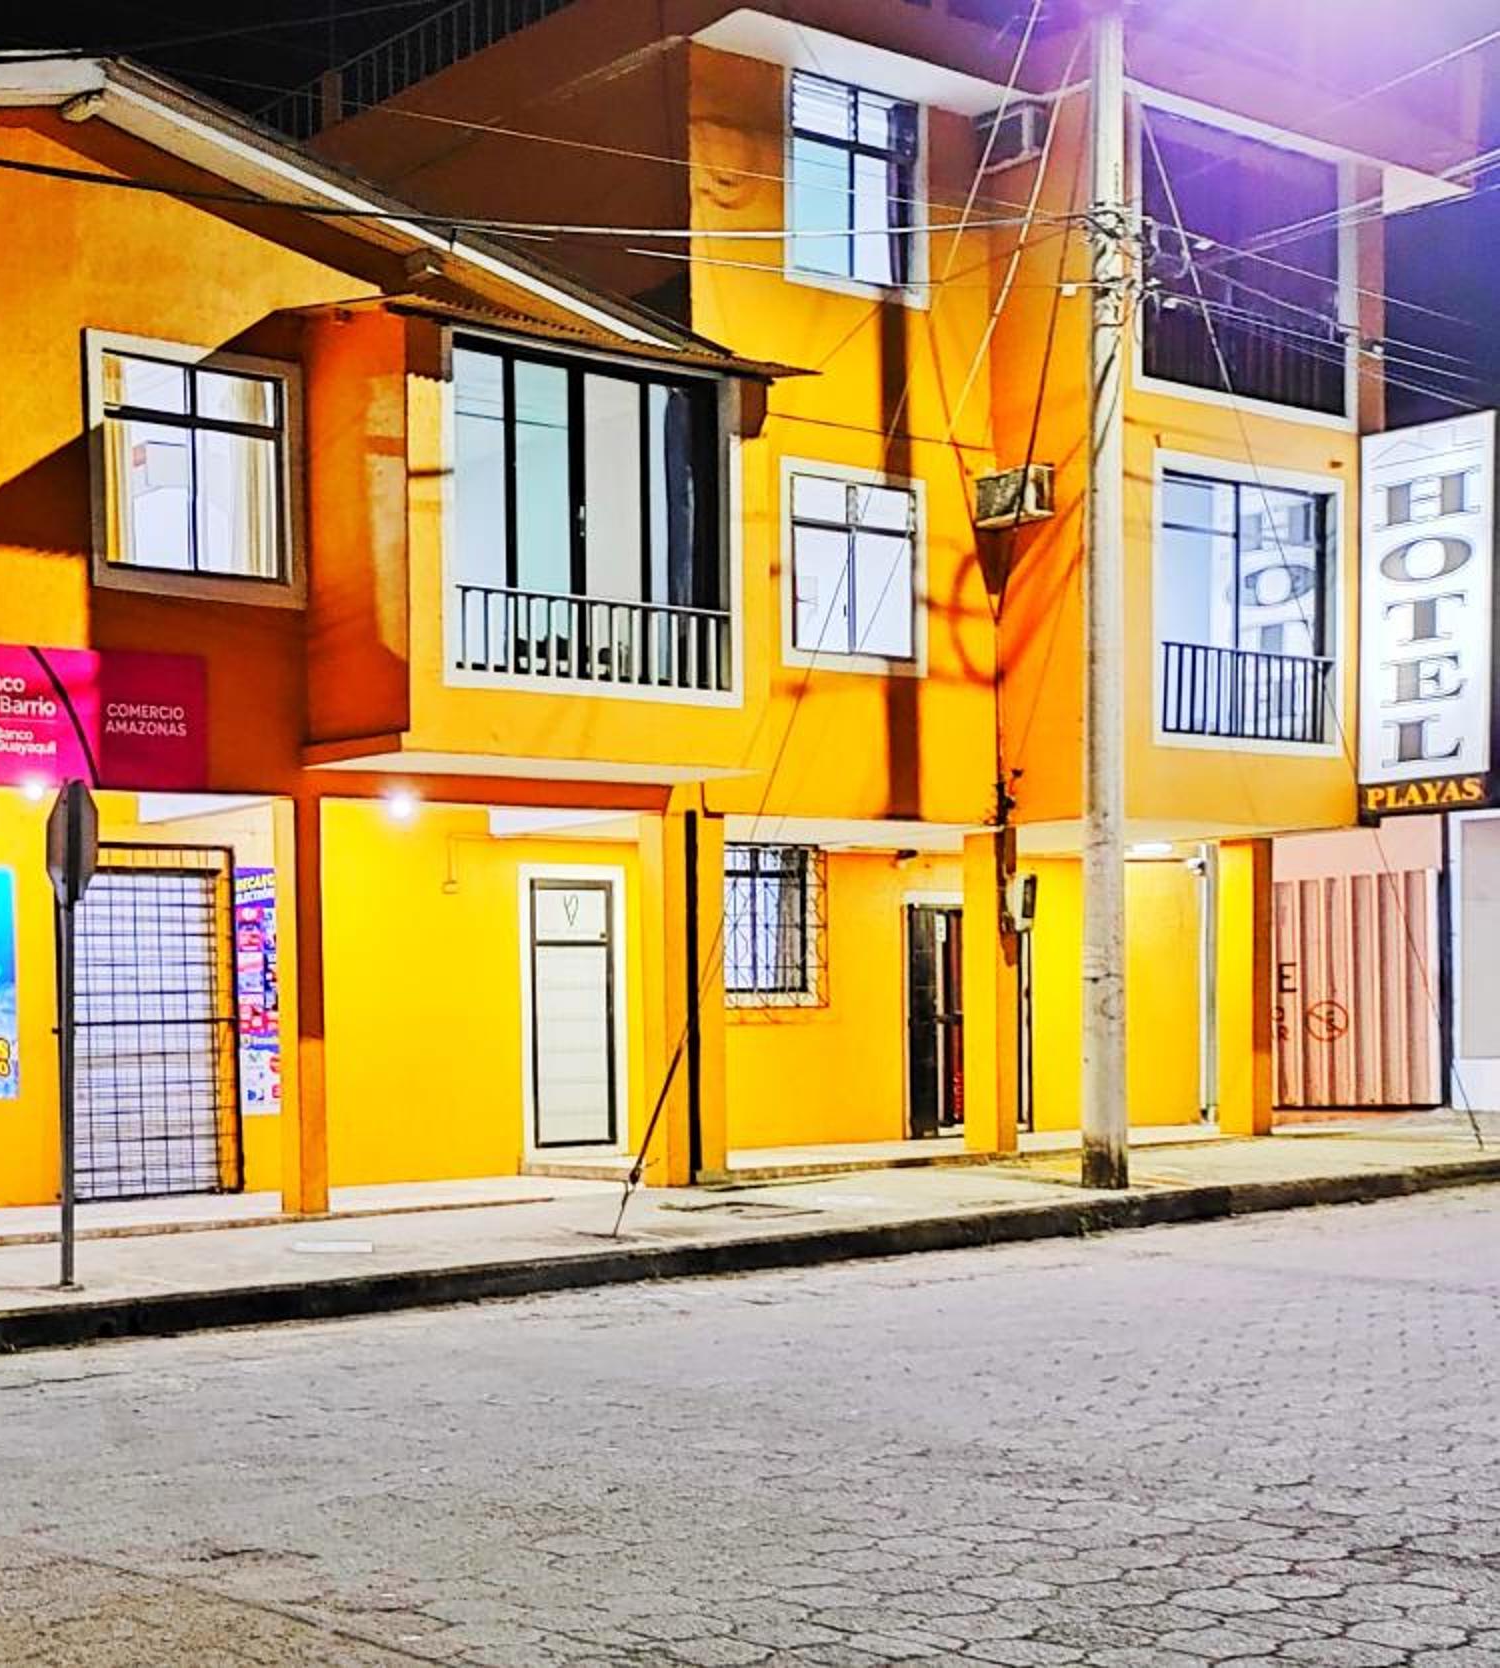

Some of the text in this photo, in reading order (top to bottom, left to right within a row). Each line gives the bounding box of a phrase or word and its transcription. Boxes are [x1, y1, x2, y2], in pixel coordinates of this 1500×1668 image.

[1373, 463, 1482, 768] HOTEL
[0, 696, 56, 717] Barrio
[107, 703, 184, 720] COMERCIO
[105, 720, 188, 737] AMAZONAS
[1366, 776, 1483, 811] PLAYAS
